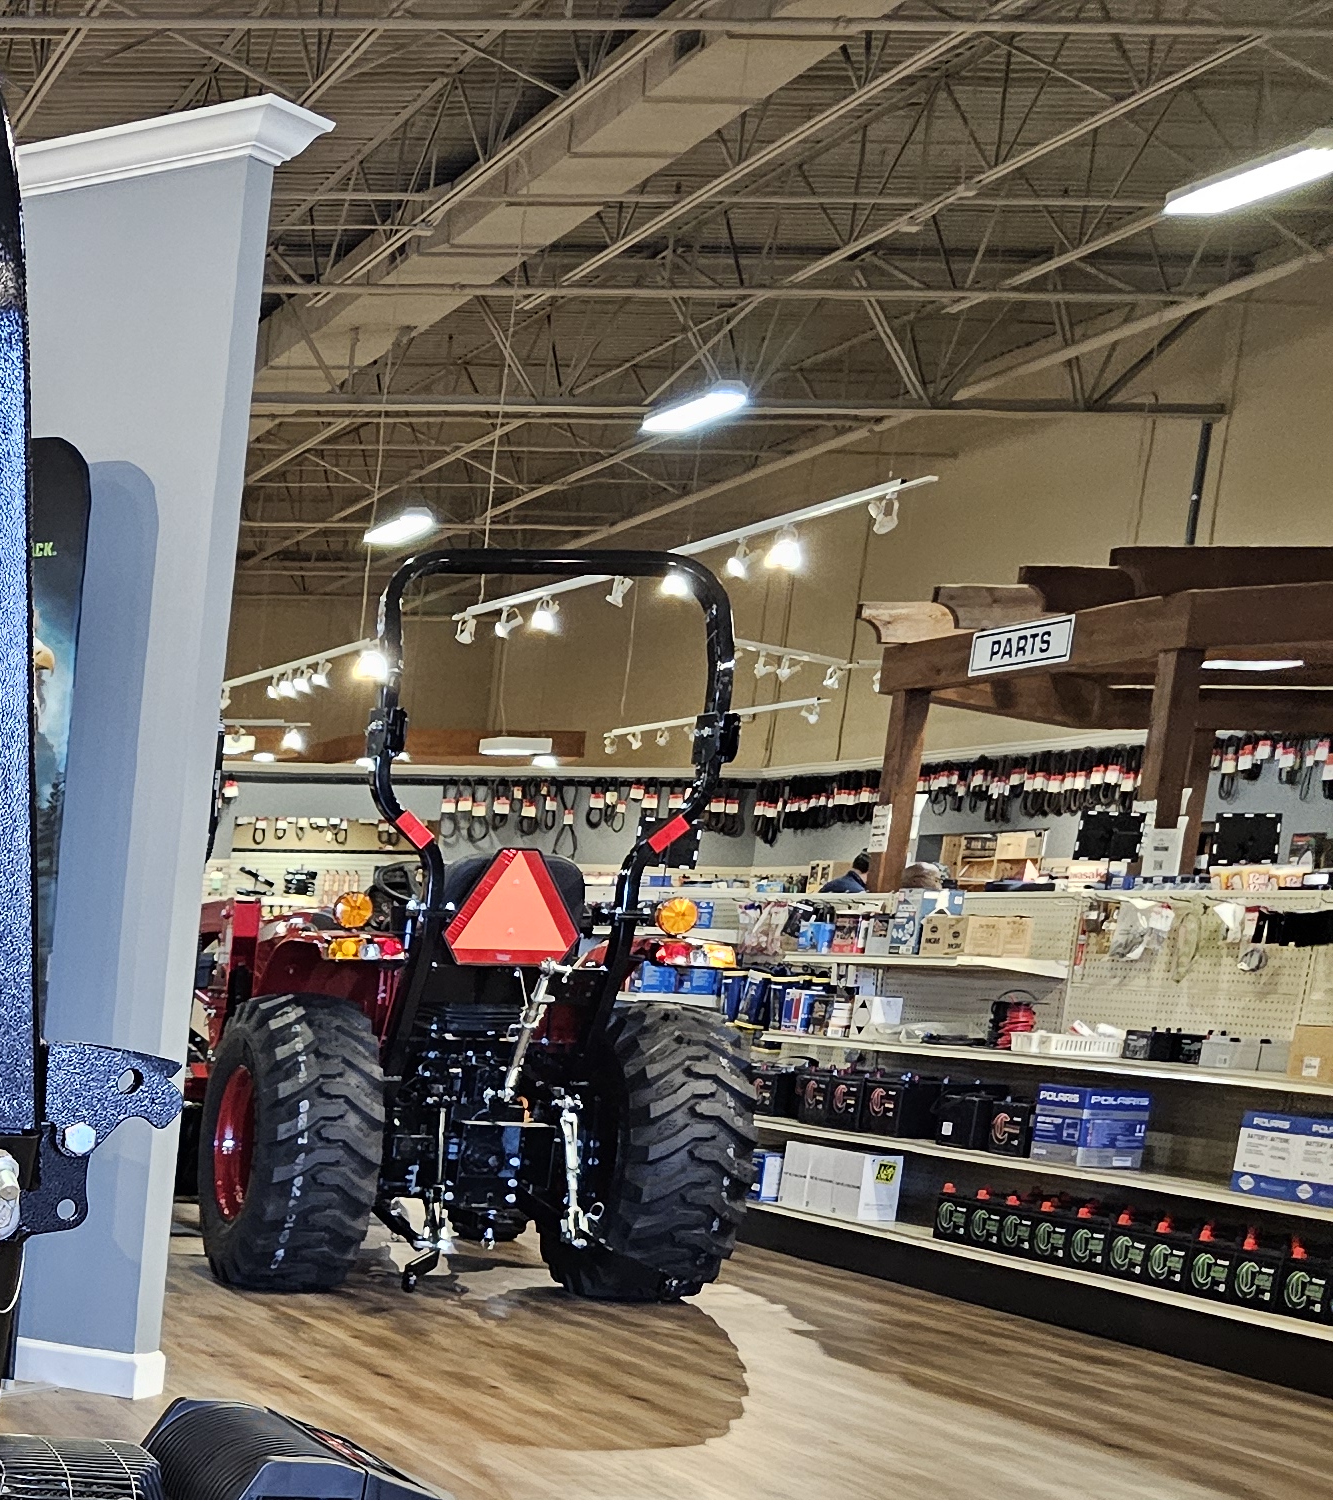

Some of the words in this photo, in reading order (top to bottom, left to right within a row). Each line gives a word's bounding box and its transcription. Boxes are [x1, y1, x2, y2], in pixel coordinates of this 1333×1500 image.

[989, 630, 1052, 662] PARTS
[1039, 1090, 1080, 1103] POLARIS
[1090, 1095, 1150, 1106] POLARIS
